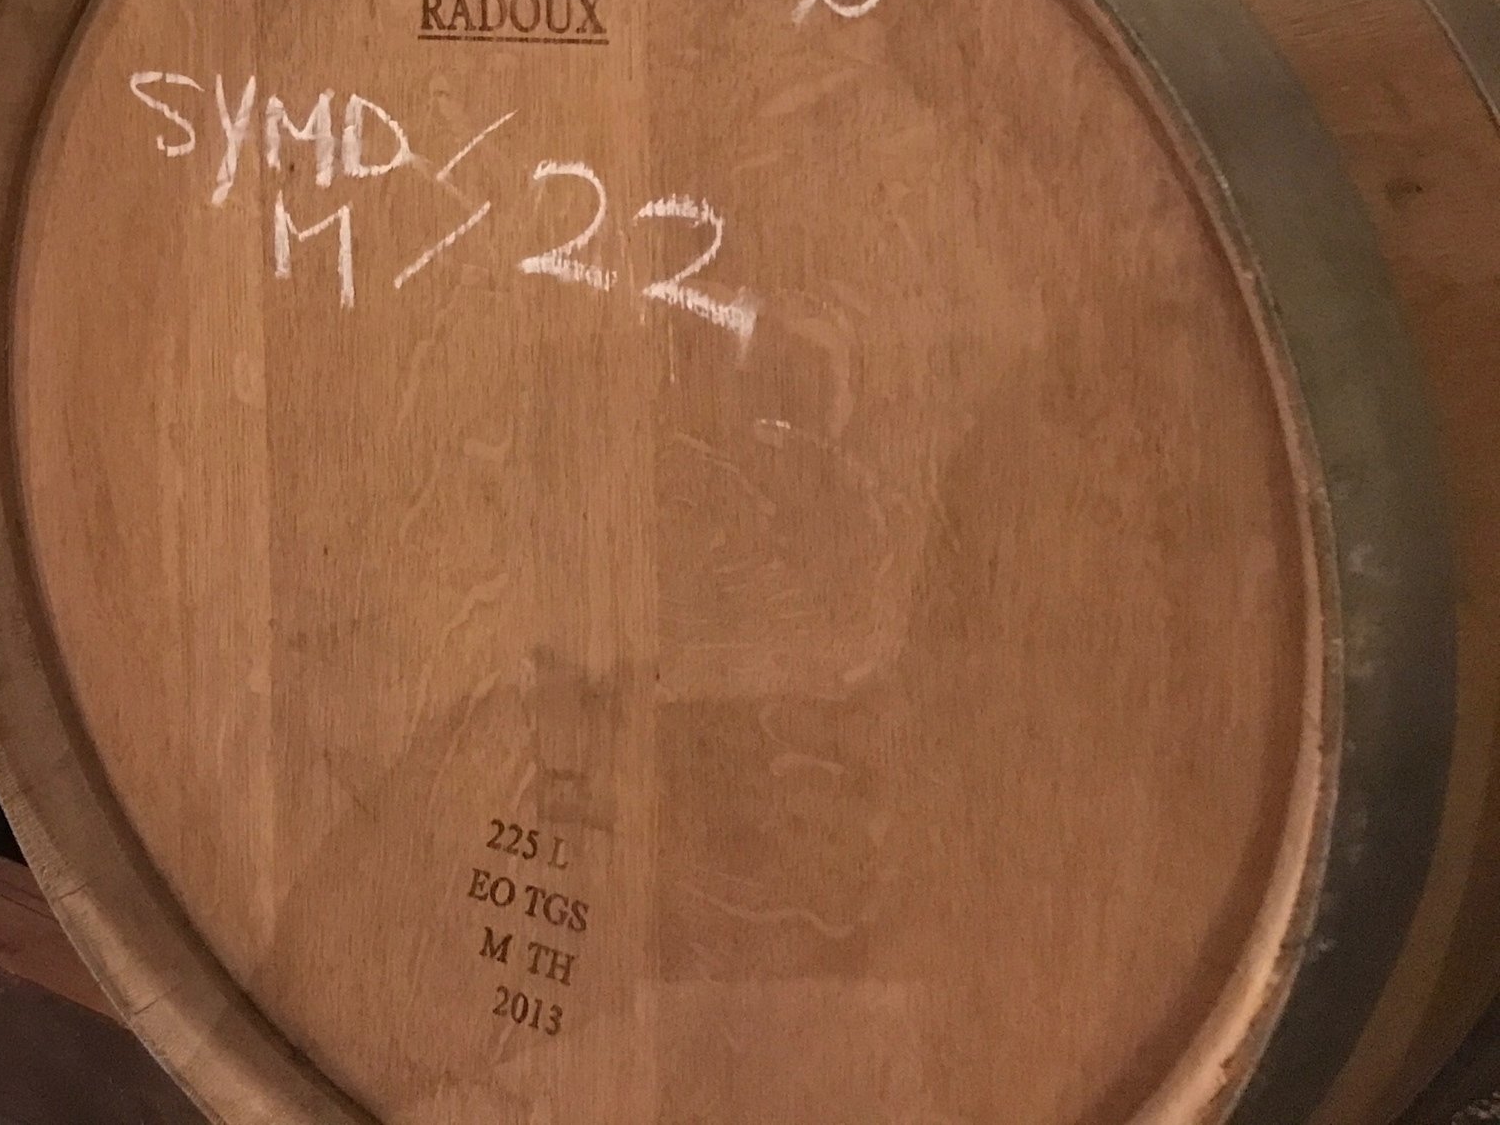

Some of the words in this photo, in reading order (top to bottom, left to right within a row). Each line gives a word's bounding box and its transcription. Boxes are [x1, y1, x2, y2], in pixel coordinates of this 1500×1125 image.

[486, 818, 539, 860] 225
[547, 836, 569, 870] L
[467, 868, 516, 907] EO
[524, 885, 589, 931] TGS
[479, 926, 513, 964] M
[527, 941, 576, 986] TH
[492, 985, 563, 1035] 2013
